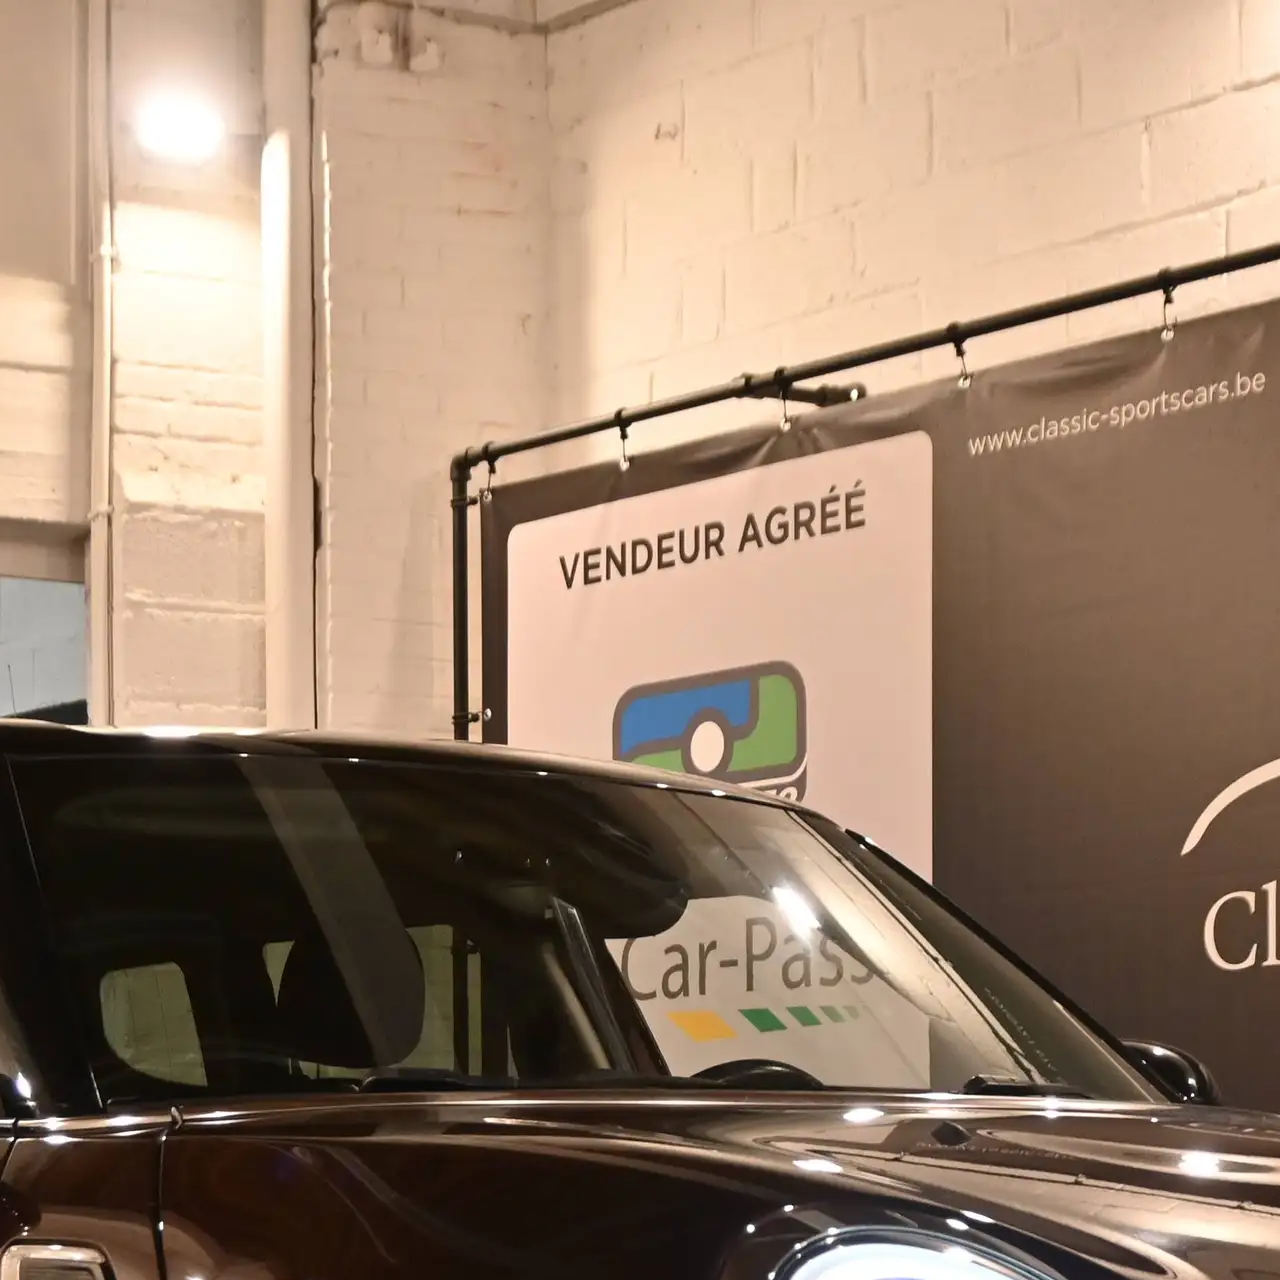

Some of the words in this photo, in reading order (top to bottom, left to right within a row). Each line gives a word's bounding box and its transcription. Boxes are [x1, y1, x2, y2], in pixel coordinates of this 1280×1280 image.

[967, 368, 1268, 456] www.classic-sportscars.be
[559, 520, 726, 590] VENDEUR
[738, 479, 867, 553] AGRÉÉ
